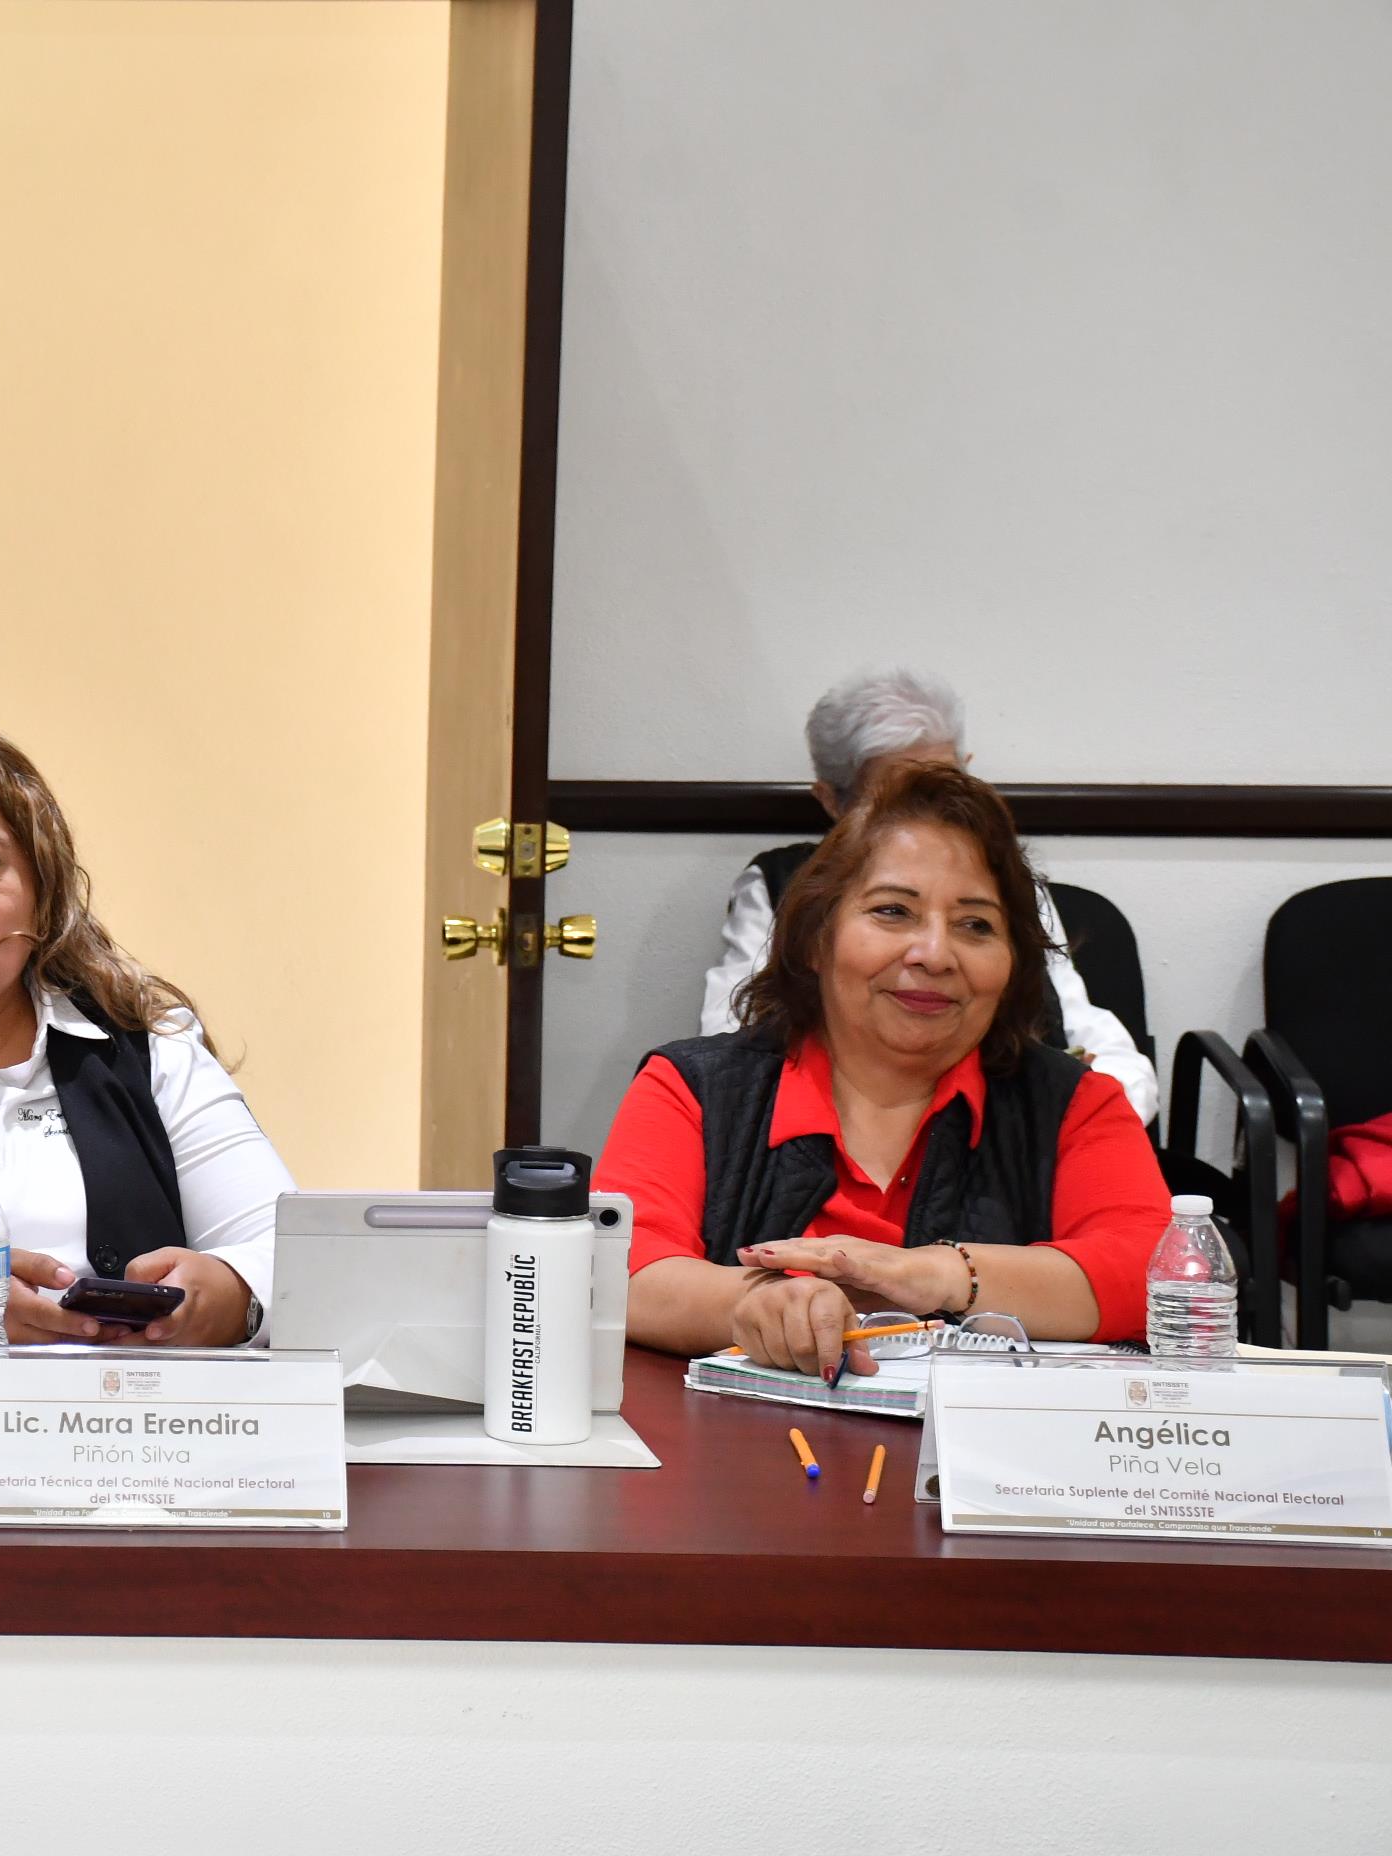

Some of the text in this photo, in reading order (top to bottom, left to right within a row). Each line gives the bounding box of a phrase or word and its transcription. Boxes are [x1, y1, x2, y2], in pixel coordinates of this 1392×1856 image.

[511, 1254, 536, 1433] BREAKFAST REPUBLIC
[3, 1411, 259, 1436] Lic. Mara Erendira
[1094, 1419, 1231, 1450] Angélica
[73, 1444, 191, 1464] Piñón Silva
[1109, 1454, 1221, 1476] Piña Vela
[40, 1475, 93, 1488] Técnica
[96, 1476, 118, 1488] del
[121, 1475, 169, 1488] Comité
[174, 1477, 234, 1489] Nacional
[238, 1477, 295, 1489] Electoral
[89, 1492, 176, 1505] del SNTISSSTE
[995, 1483, 1345, 1506] Secretaria Suplente del Comité Nacional Electoral
[1124, 1504, 1215, 1518] del SNTISSSTE
